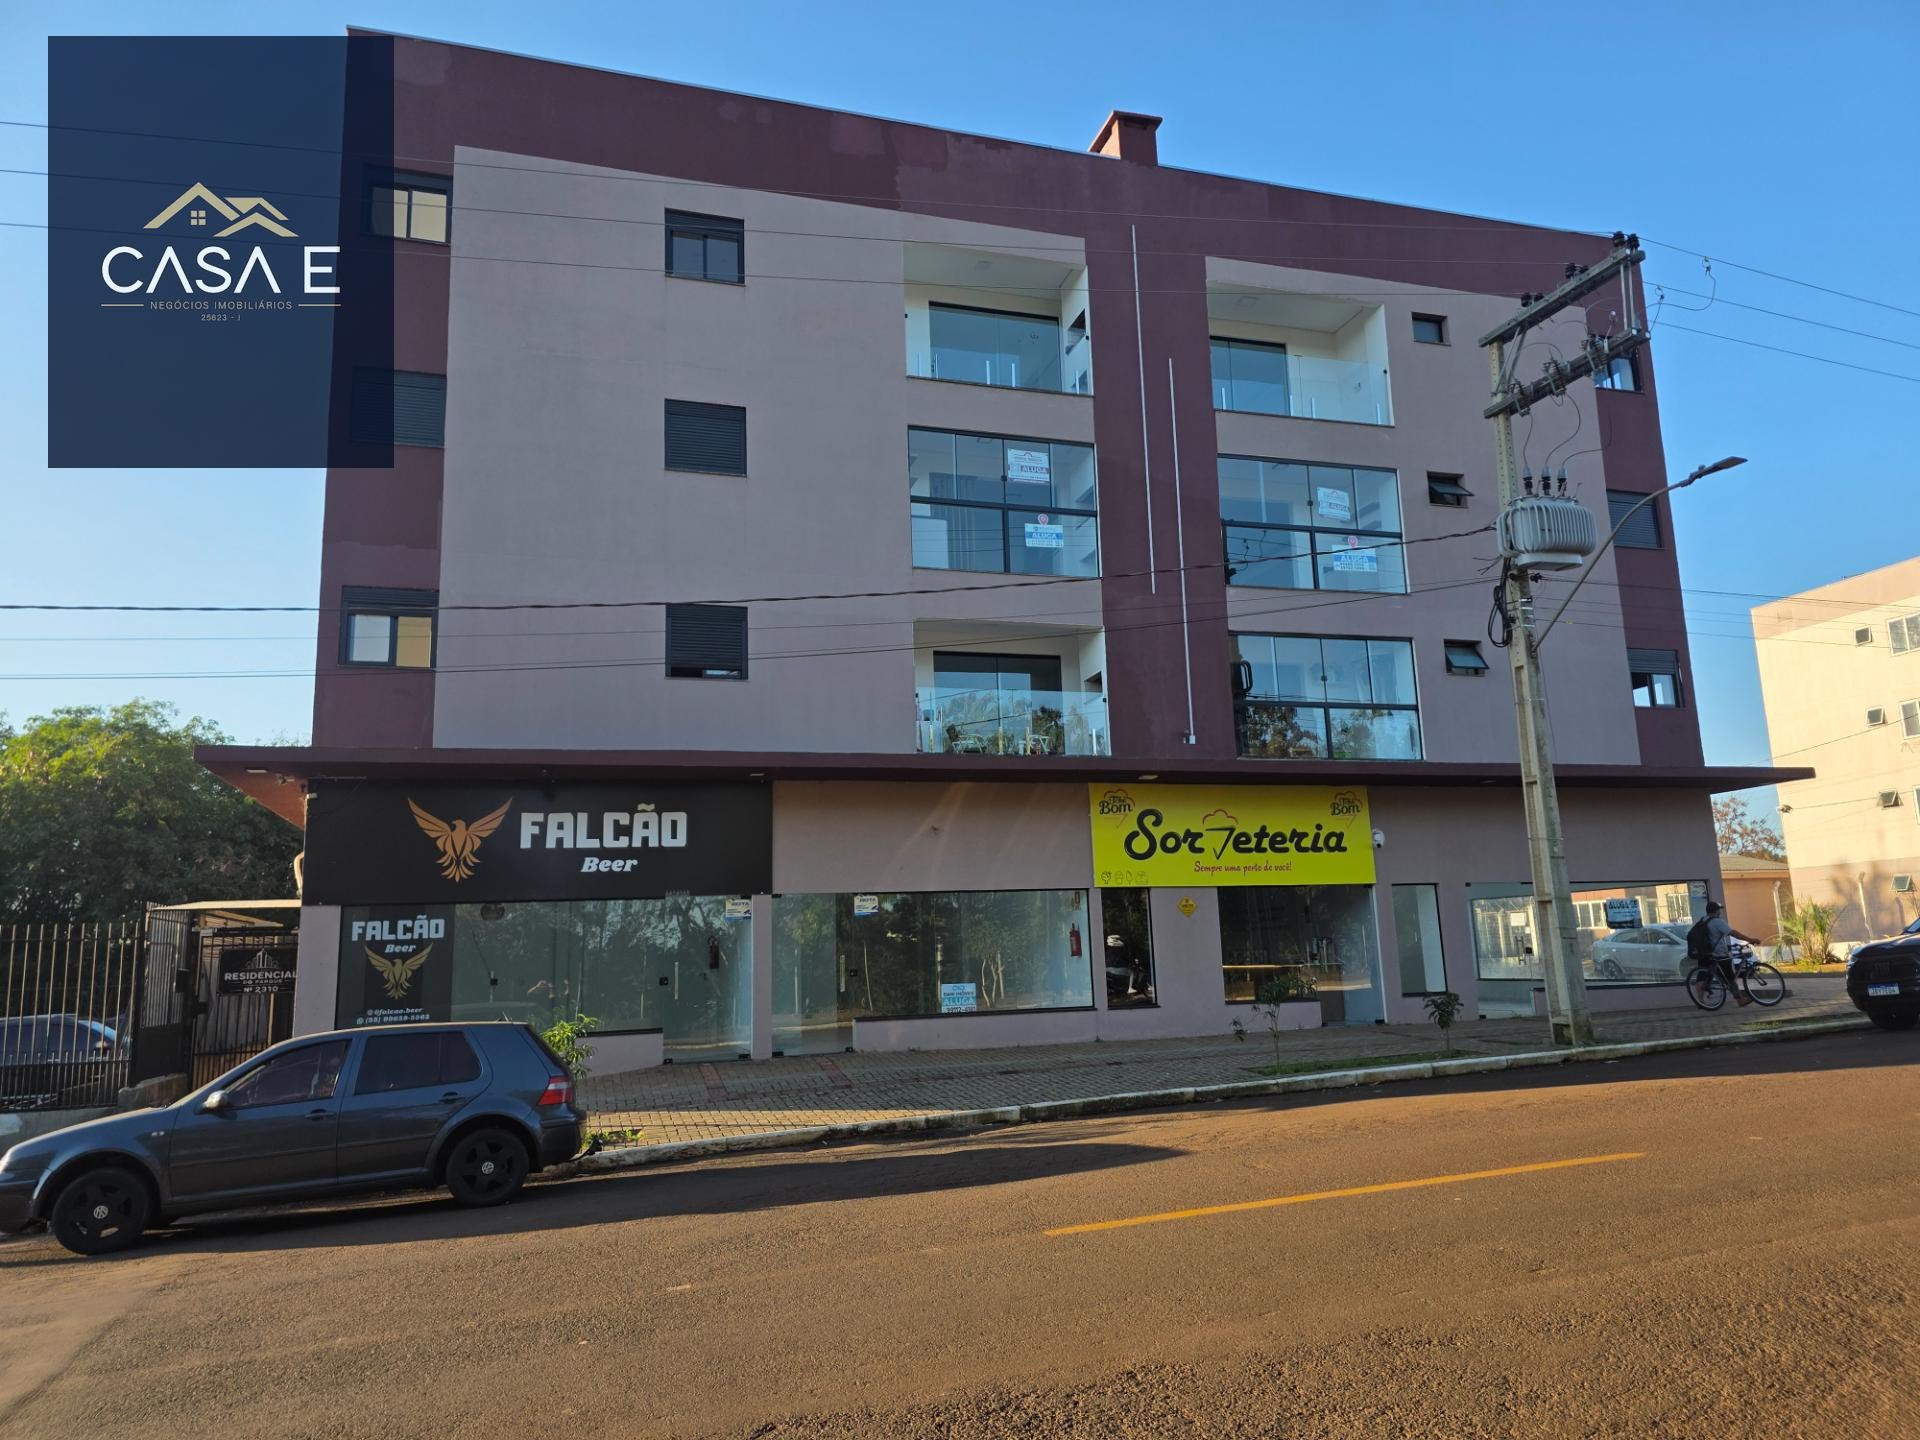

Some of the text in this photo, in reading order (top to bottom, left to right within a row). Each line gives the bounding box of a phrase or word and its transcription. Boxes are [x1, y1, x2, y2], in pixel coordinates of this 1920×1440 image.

[1340, 555, 1369, 563] ALUGA
[1099, 800, 1133, 815] Bom
[1330, 802, 1360, 816] Bom
[520, 803, 688, 849] FALCÃO
[580, 857, 638, 873] Beer
[1194, 861, 1222, 877] Sempre
[1263, 860, 1273, 872] de
[351, 914, 445, 942] FALCÃO
[384, 943, 416, 953] Beer
[224, 970, 298, 981] RESIDENCIAL
[943, 996, 976, 1006] ALUGA
